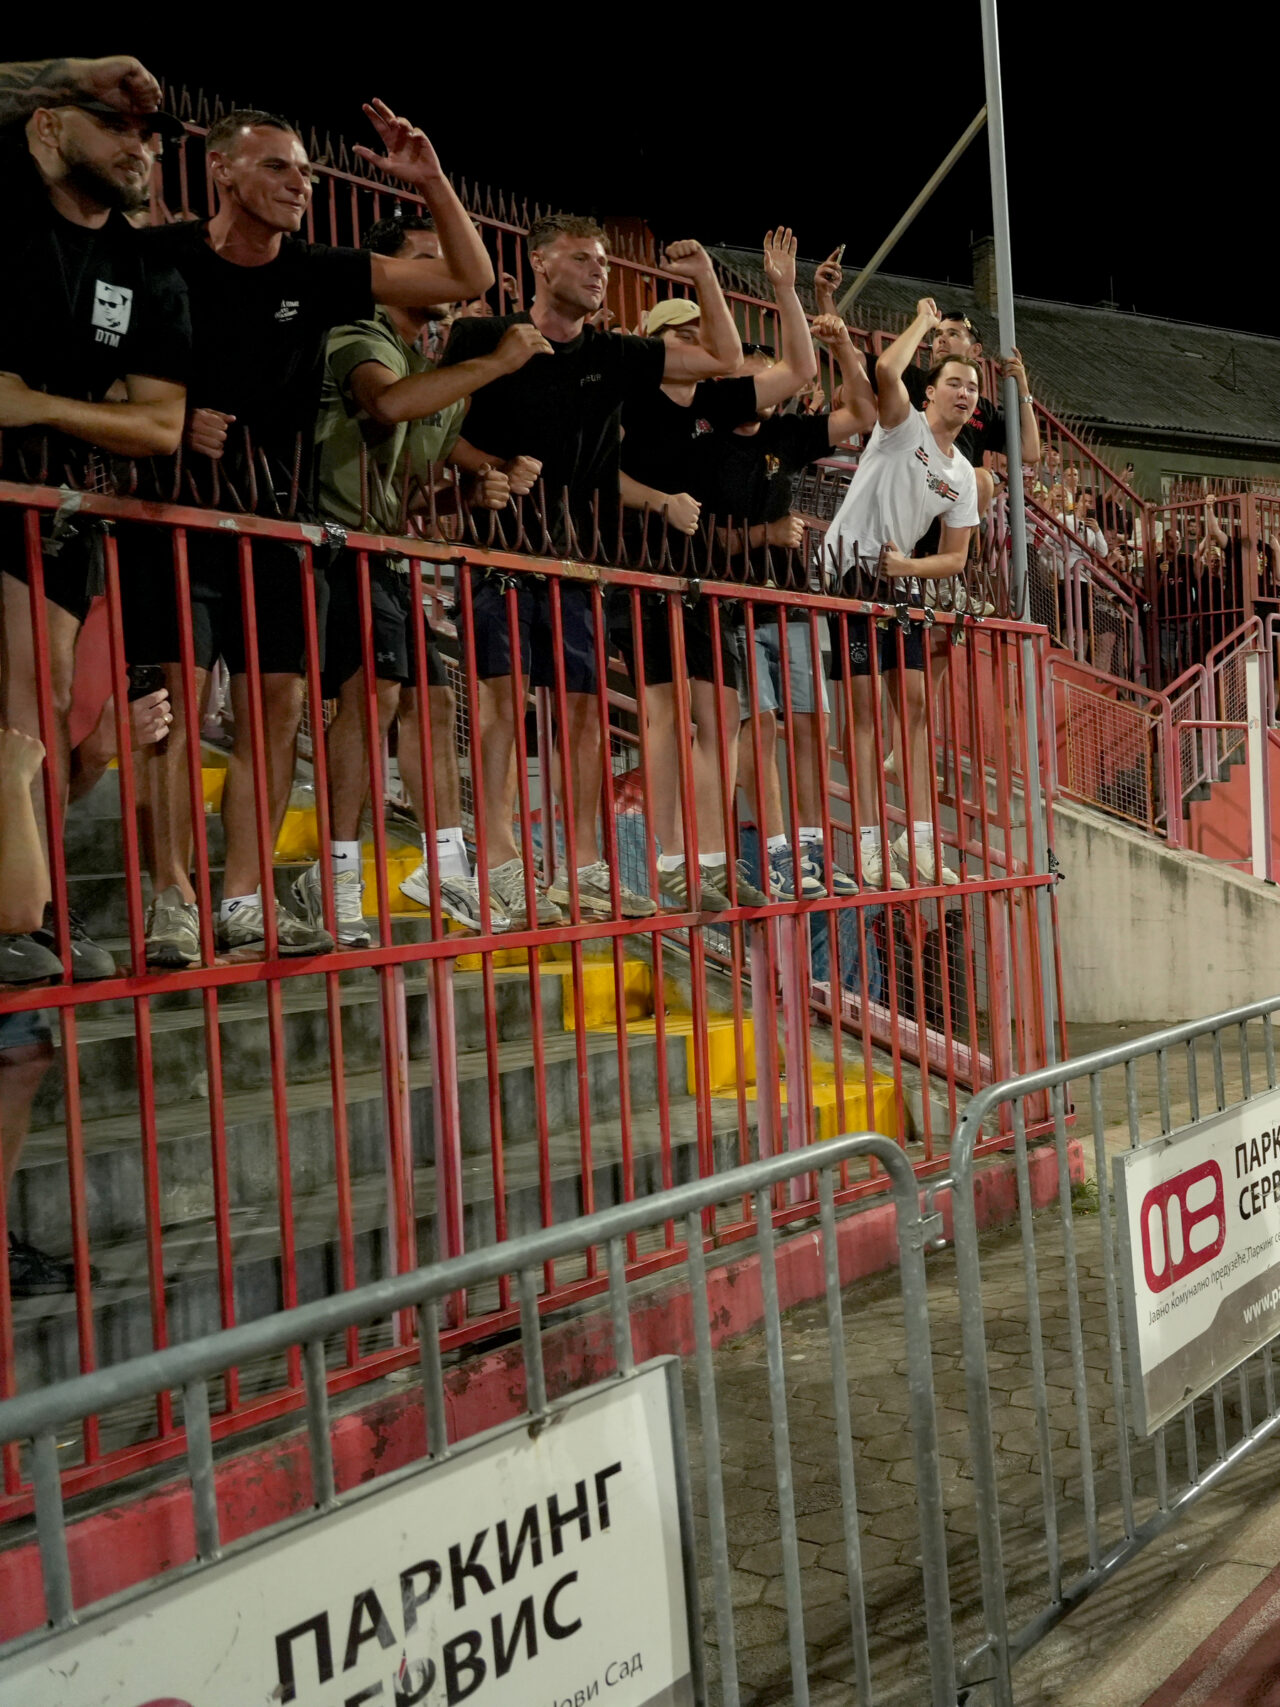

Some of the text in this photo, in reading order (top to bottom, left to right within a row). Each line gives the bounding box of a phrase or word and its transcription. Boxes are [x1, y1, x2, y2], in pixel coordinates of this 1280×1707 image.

[95, 328, 121, 348] DTM
[274, 1461, 622, 1706] ПАРКИНГ
[604, 1652, 643, 1687] Сад
